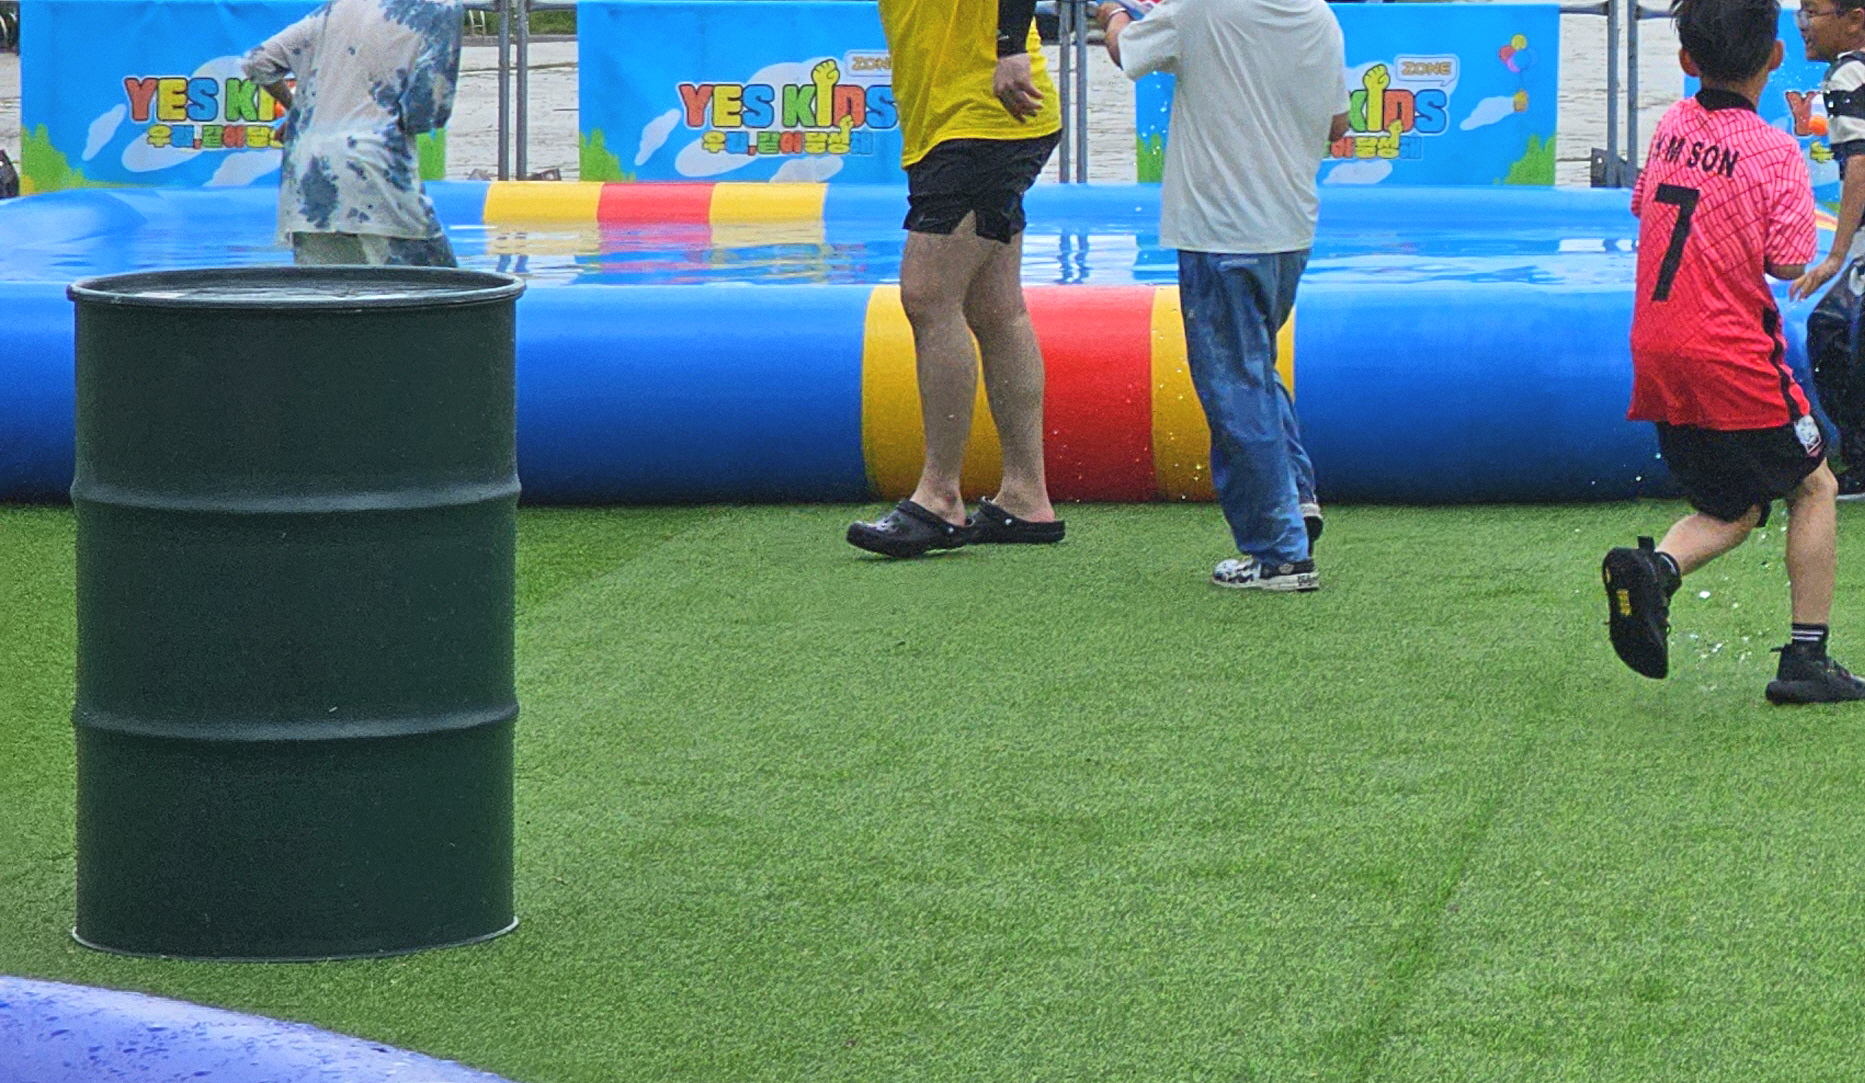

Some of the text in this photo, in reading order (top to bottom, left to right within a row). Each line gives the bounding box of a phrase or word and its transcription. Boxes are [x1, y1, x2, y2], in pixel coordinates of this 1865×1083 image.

[852, 56, 892, 70] ZON
[1402, 61, 1451, 76] ZONE
[124, 78, 218, 122] YES
[679, 84, 774, 128] YES
[1687, 141, 1740, 178] SON
[1651, 182, 1701, 302] 7
